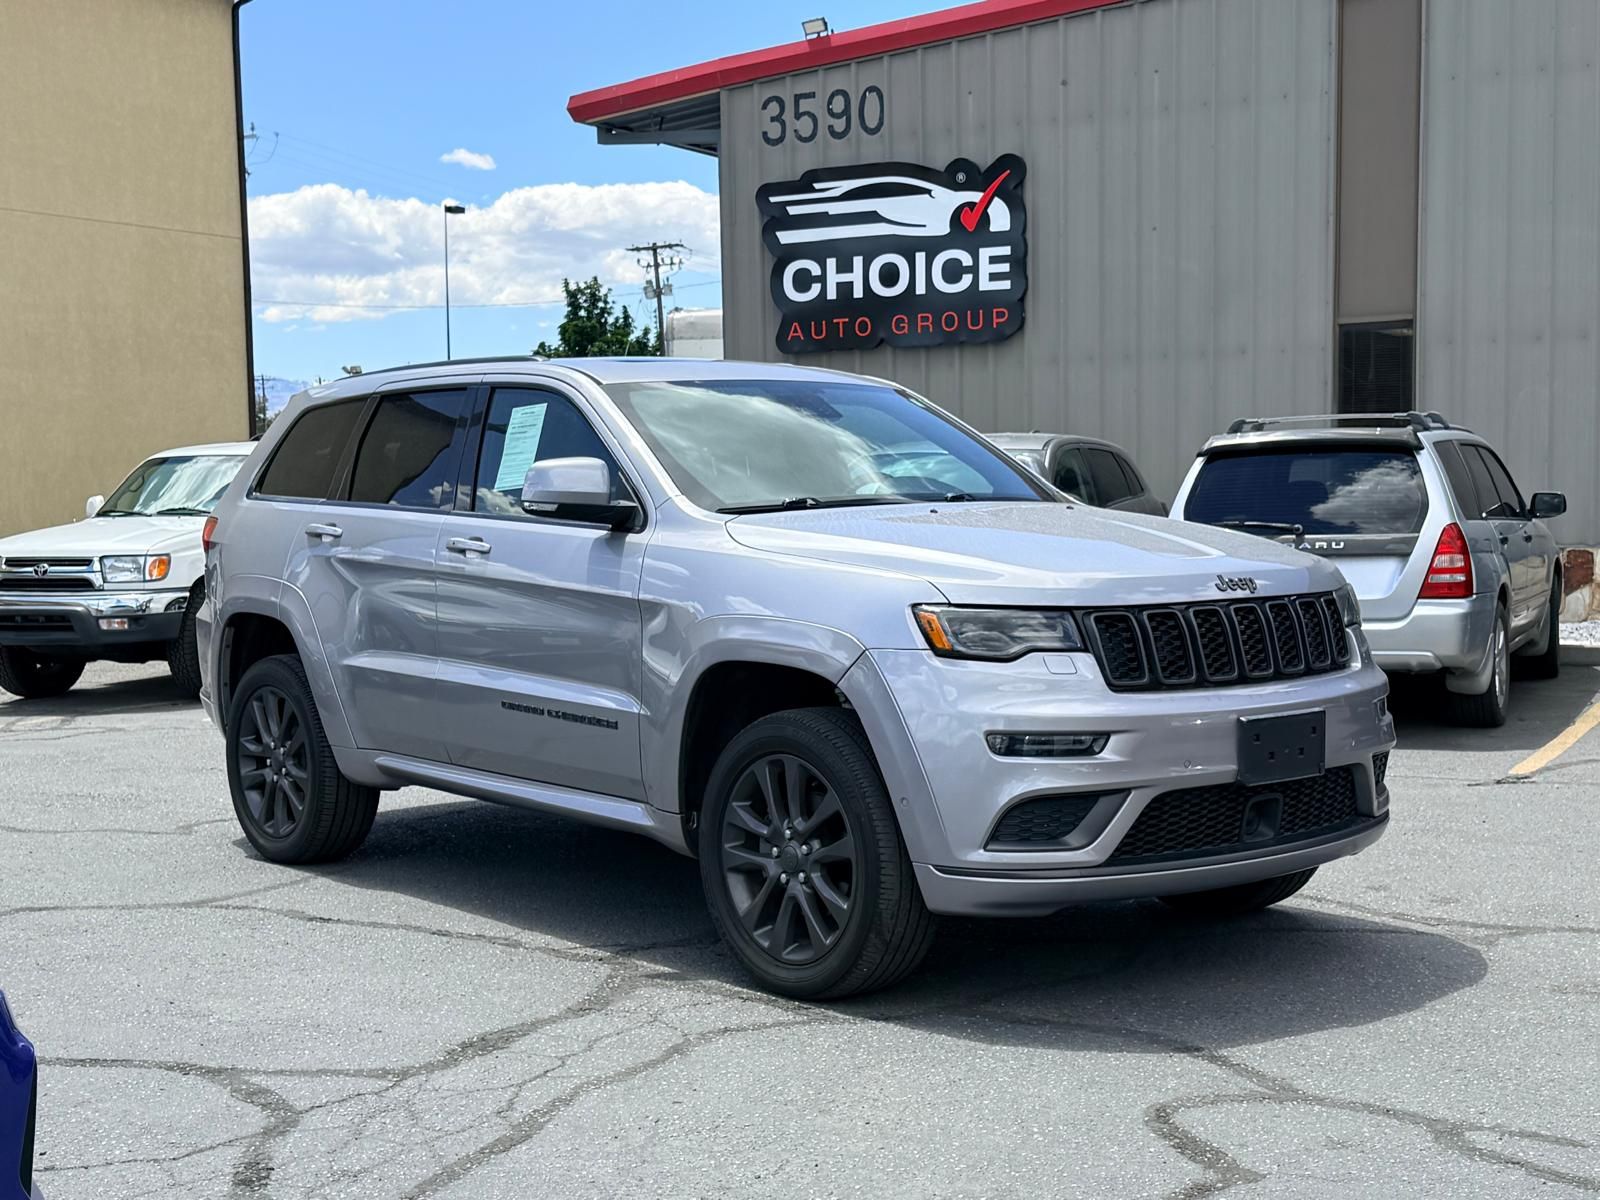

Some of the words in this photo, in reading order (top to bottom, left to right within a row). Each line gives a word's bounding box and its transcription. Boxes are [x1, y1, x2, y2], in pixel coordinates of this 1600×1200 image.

[761, 85, 885, 147] 3590
[782, 245, 1011, 303] CHOICE
[787, 317, 873, 342] AUTO
[892, 308, 1009, 334] GROUP
[1215, 574, 1257, 593] Jeep
